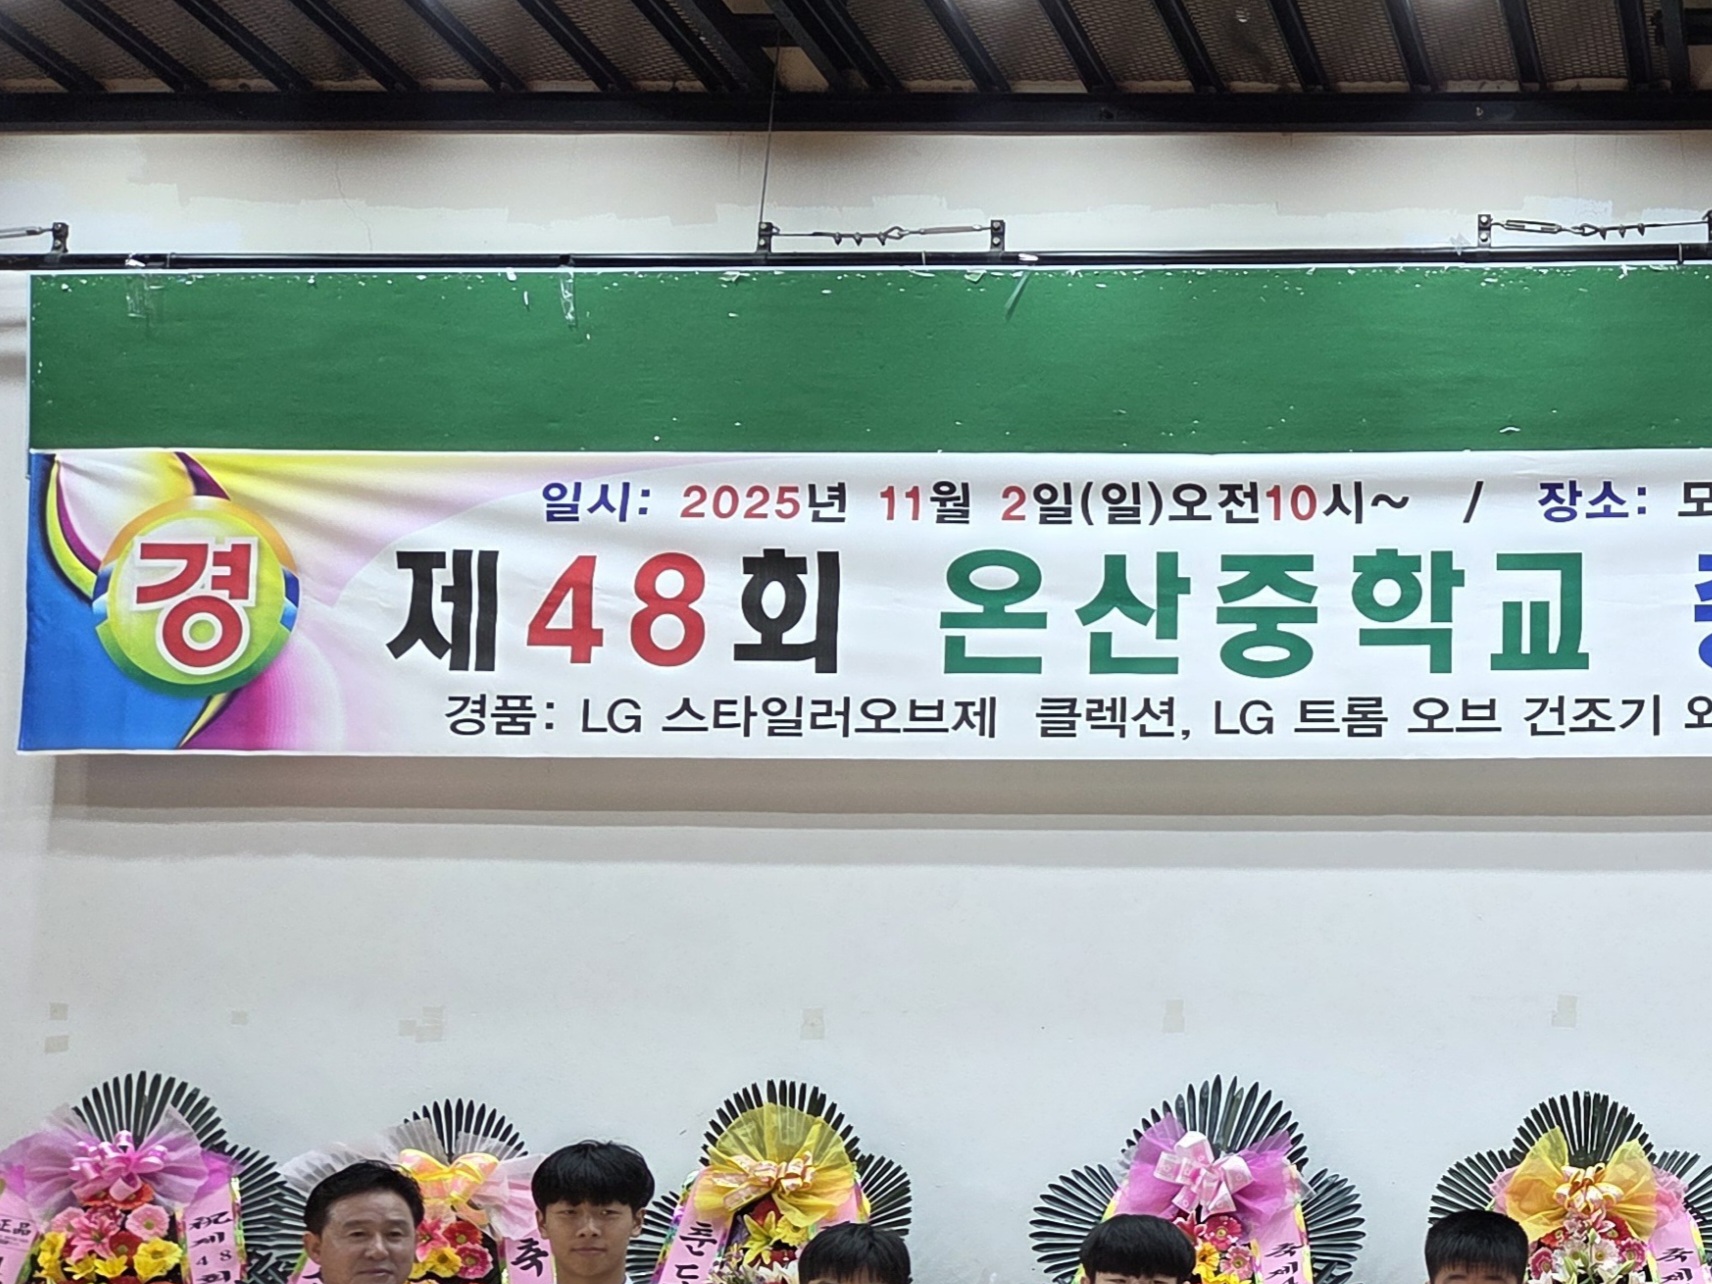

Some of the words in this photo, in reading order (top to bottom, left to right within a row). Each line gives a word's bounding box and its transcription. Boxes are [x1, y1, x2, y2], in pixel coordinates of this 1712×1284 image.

[541, 481, 651, 523] 일시:
[680, 481, 847, 523] 2025년
[879, 480, 971, 525] 11월
[1001, 480, 1410, 526] 2일(일)오전10시~
[1462, 481, 1485, 524] /
[1537, 480, 1648, 523] 장소:
[136, 540, 253, 668] 경
[386, 548, 841, 674] 제48회
[939, 547, 1590, 679] 온산중학교
[444, 693, 555, 737] 경품:
[581, 697, 642, 735] LG
[661, 694, 997, 739] 스타일러오브제
[1035, 696, 1191, 741] 클렉션,
[1214, 699, 1274, 736] LG
[1293, 696, 1389, 738] 트롬
[1407, 697, 1503, 734] 오브
[1523, 694, 1661, 737] 건조기
[510, 1237, 549, 1277] 축
